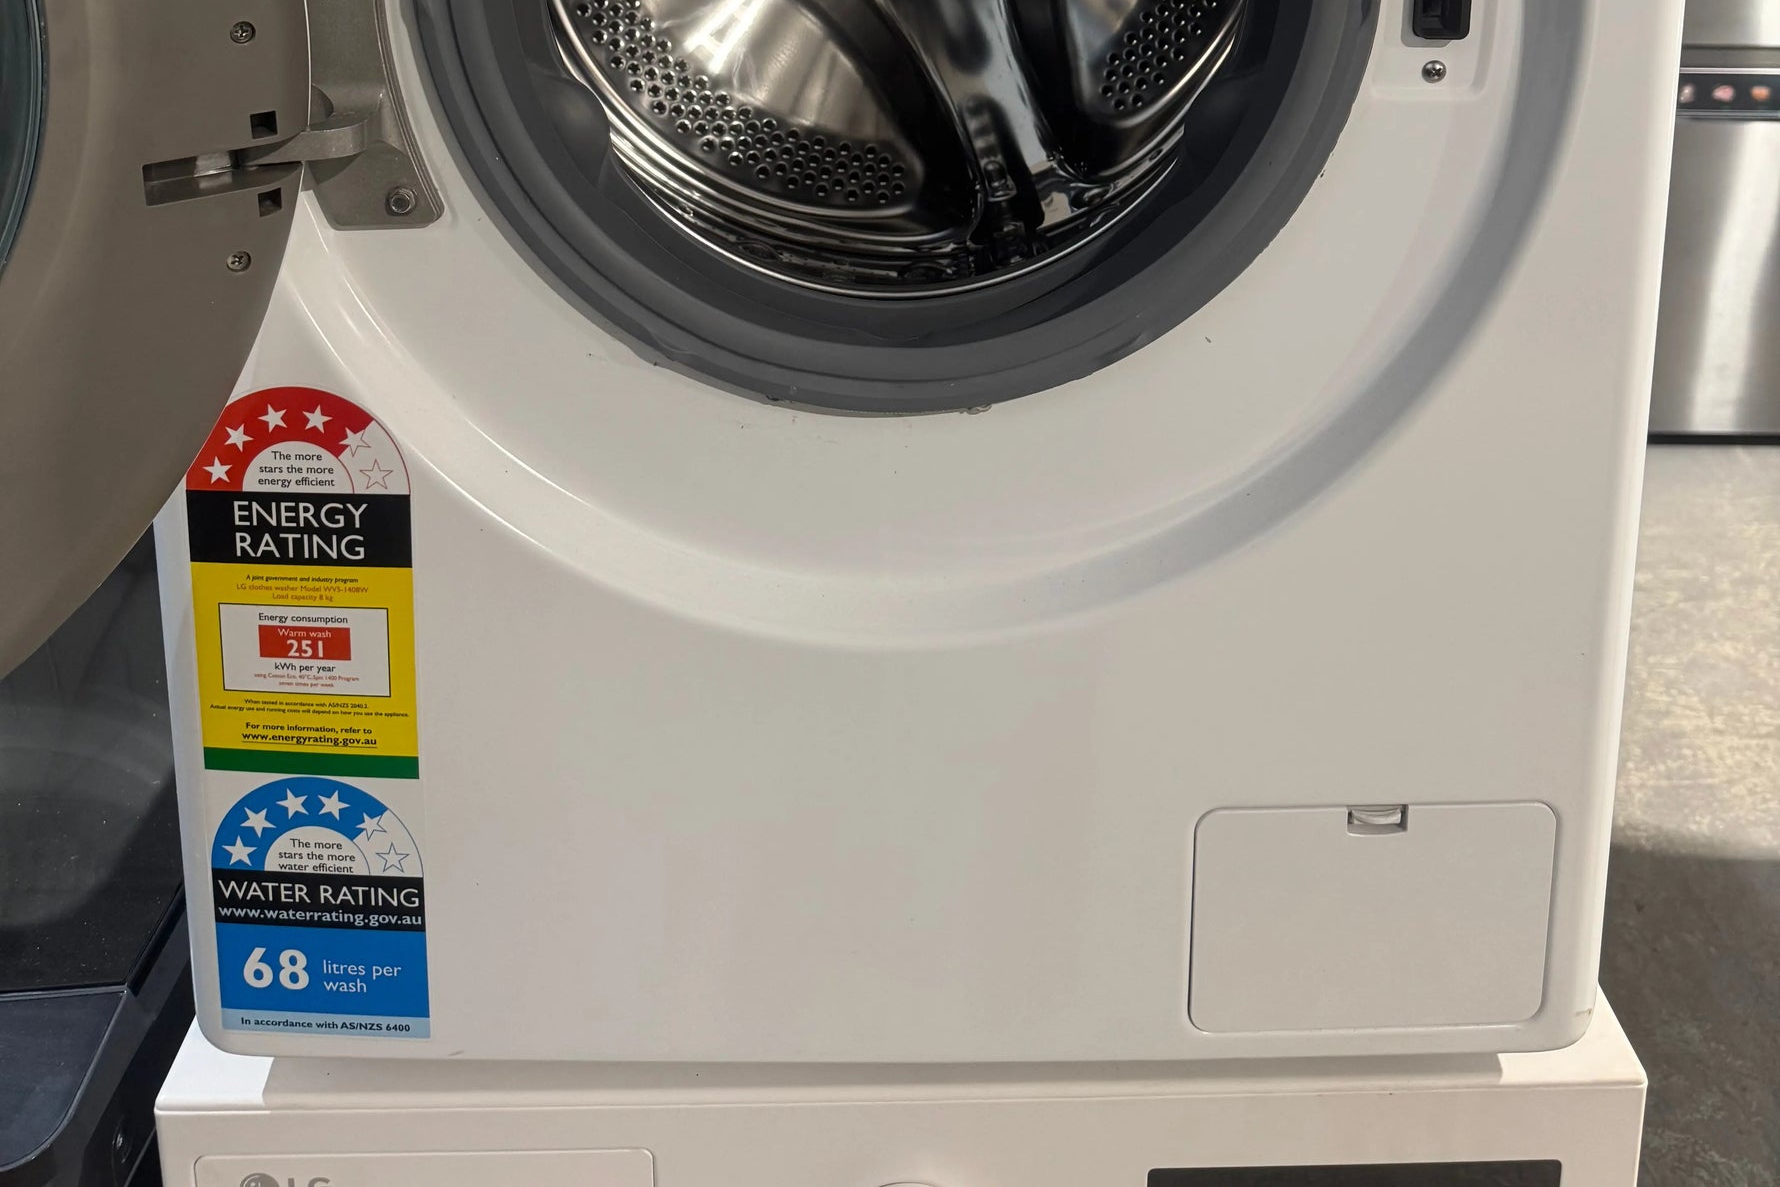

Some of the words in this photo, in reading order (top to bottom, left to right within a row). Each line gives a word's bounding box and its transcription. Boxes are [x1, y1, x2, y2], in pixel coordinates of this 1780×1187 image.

[271, 451, 292, 461] The
[294, 452, 323, 461] more
[259, 465, 284, 474] stars
[286, 464, 303, 474] the
[306, 466, 334, 474] more
[258, 478, 292, 488] energy
[295, 477, 335, 487] efficient
[233, 500, 368, 529] ENERGY
[235, 532, 365, 560] RATING
[259, 613, 288, 623] Energy
[291, 614, 348, 625] consumption
[278, 628, 307, 637] Warm
[309, 629, 332, 638] wash
[287, 639, 323, 658] 251
[275, 662, 296, 671] kWh
[299, 664, 314, 673] per
[317, 665, 336, 674] year
[246, 722, 260, 730] For
[287, 724, 338, 734] information,
[340, 726, 361, 734] refer
[242, 733, 377, 746] www.energyrating.gov.au
[290, 838, 311, 848] The
[314, 842, 342, 850] more
[278, 851, 303, 860] stars
[306, 851, 324, 860] the
[327, 854, 355, 862] more
[278, 863, 309, 871] water
[312, 863, 354, 873] efficient
[218, 879, 311, 903] WATER
[320, 885, 420, 908] RATING
[218, 906, 422, 926] www.waterrating.gov.au
[243, 947, 310, 990] 68
[323, 960, 366, 975] litres
[372, 966, 402, 980] per
[323, 978, 367, 992] wash
[241, 1017, 251, 1025] In
[254, 1019, 313, 1028] accordance
[315, 1020, 338, 1029] with
[340, 1021, 383, 1031] AS/NZS
[386, 1023, 411, 1032] 6400
